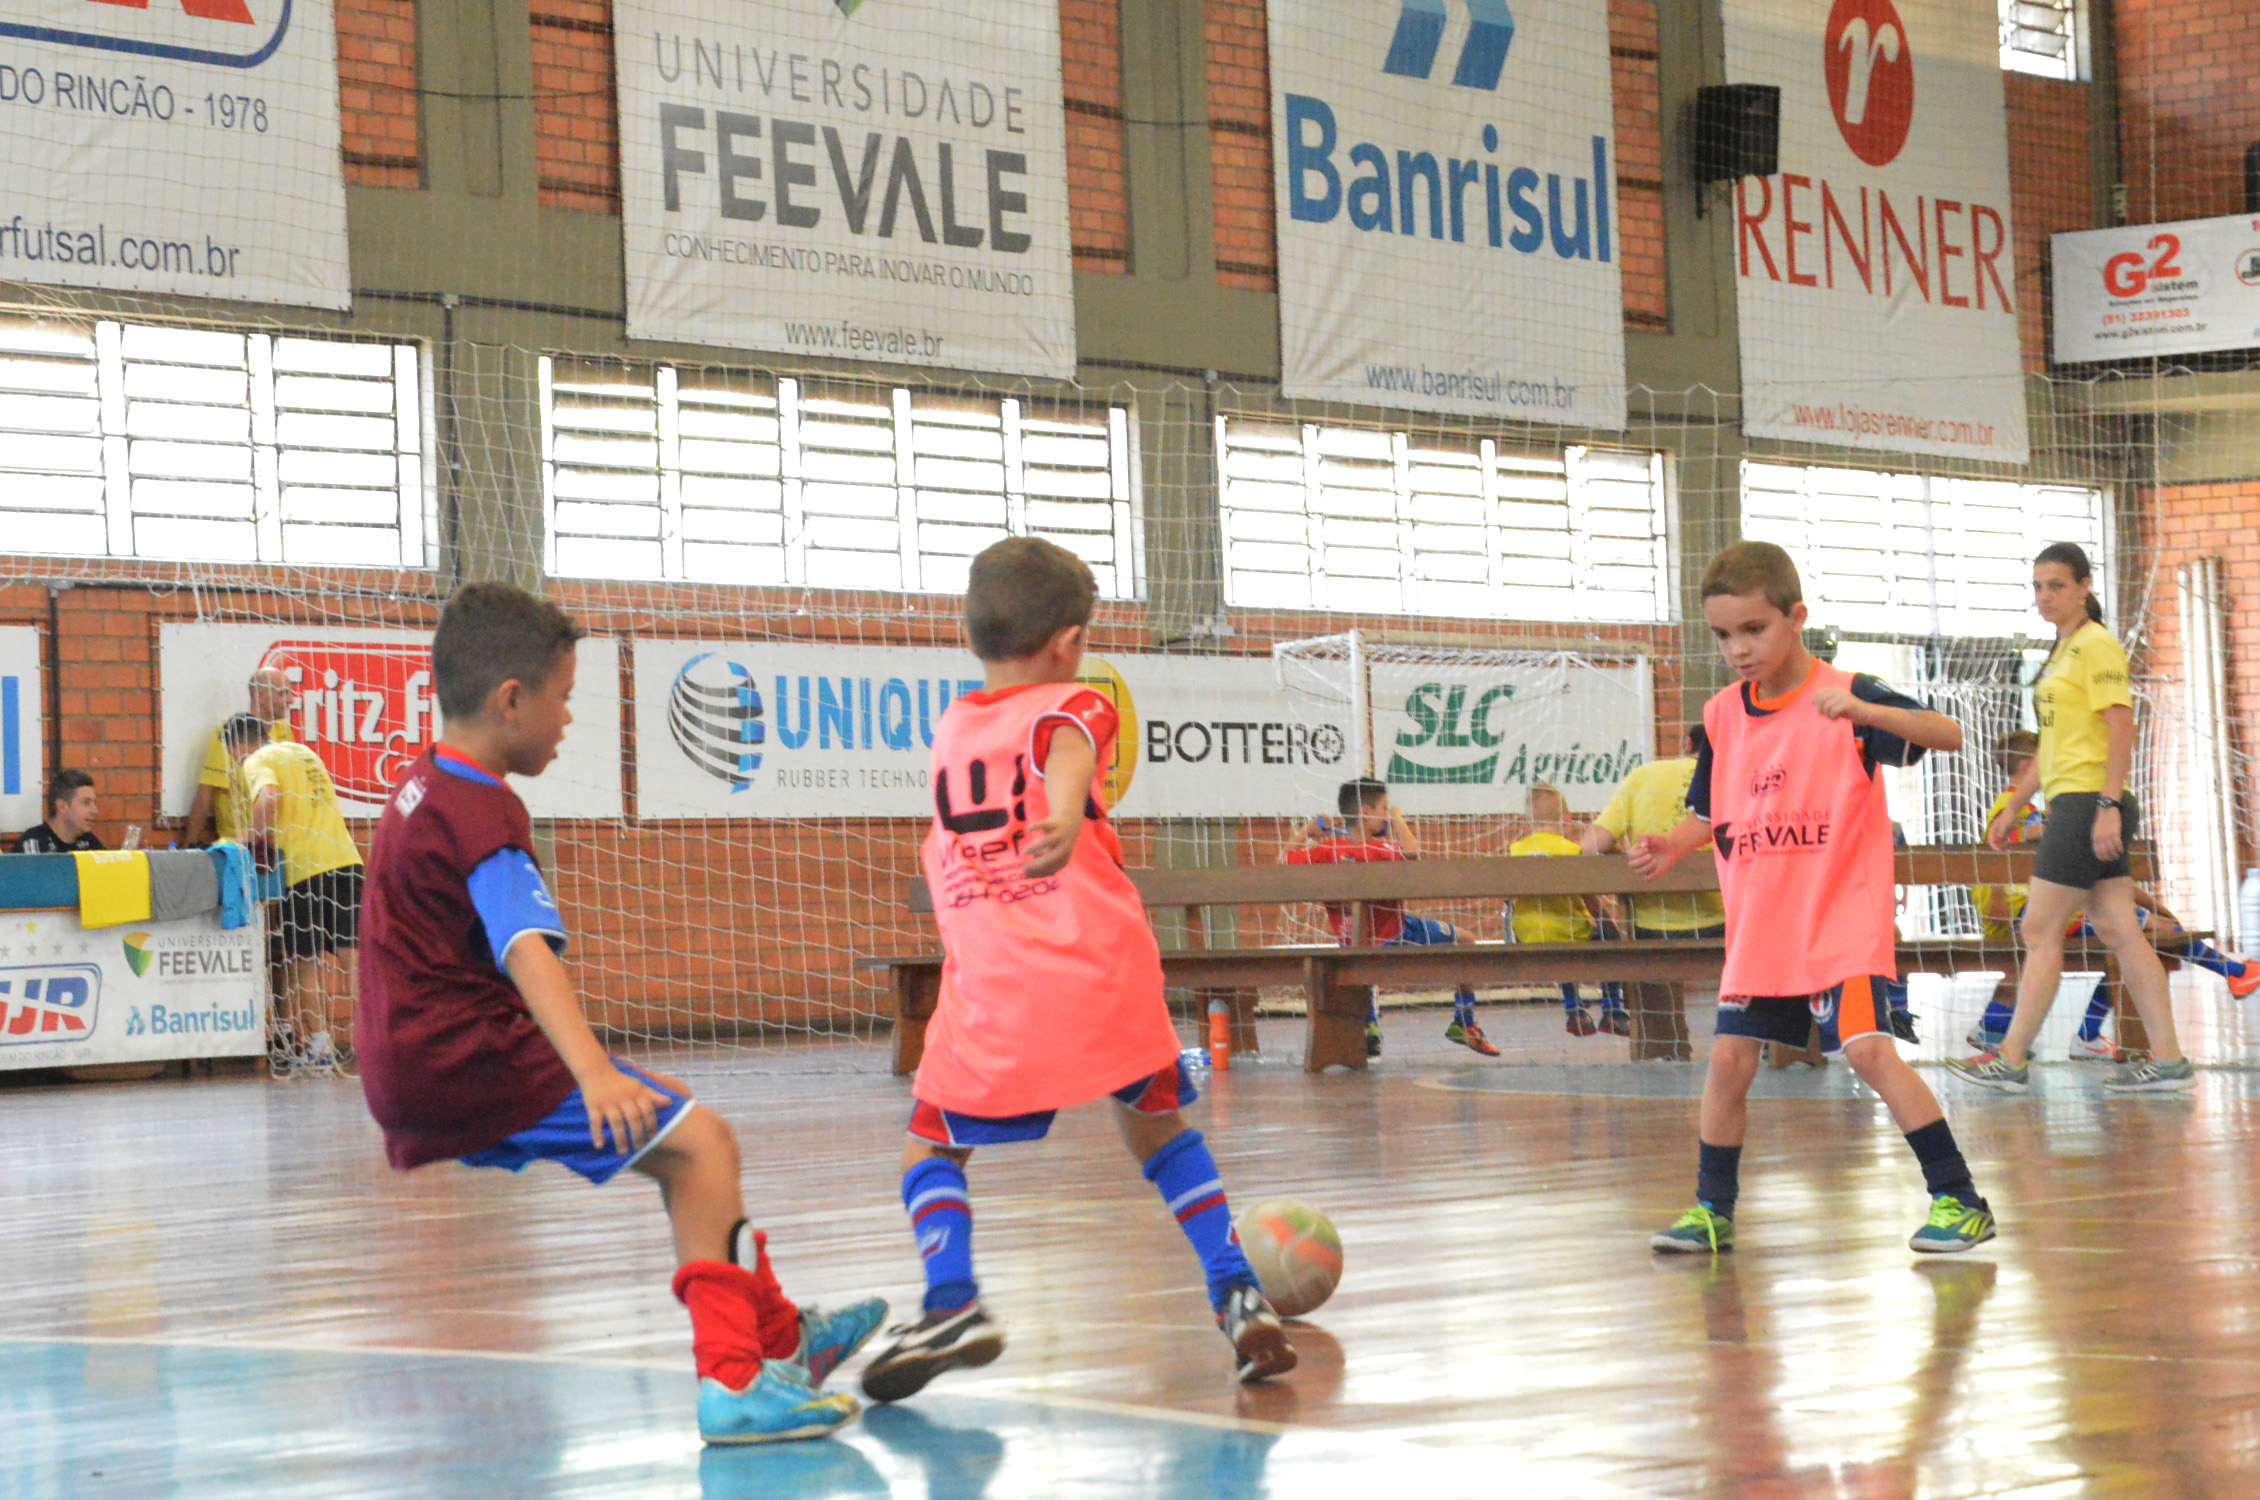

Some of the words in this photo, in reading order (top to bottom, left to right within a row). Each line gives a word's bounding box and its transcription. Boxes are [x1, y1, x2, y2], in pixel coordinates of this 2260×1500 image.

[0, 64, 44, 104] DO
[55, 72, 175, 122] RINCÃO
[205, 92, 270, 133] 1978
[656, 32, 1026, 134] UNIVERSIDADE
[658, 101, 1033, 254] FEEVALE
[1285, 92, 1612, 263] Banrisul
[664, 232, 822, 273] CONHECIMENTO
[825, 253, 875, 279] PARA
[879, 257, 947, 287] INOVAR
[949, 267, 965, 288] O
[967, 267, 1034, 297] MUNDO
[1736, 171, 2014, 315] RENNER
[2103, 232, 2182, 298] G2
[785, 320, 943, 358] www.feevale.br
[1365, 362, 1577, 409] www.banrisul.com.br
[1792, 401, 1996, 446] www.lojasrenner.com.br
[1396, 682, 1516, 748] SLC
[777, 768, 850, 788] RUBBER
[859, 768, 928, 789] TECHNO
[158, 933, 254, 949] UNIVERSIDADE
[159, 950, 254, 976] FEEVALE
[151, 999, 256, 1035] Banrisul
